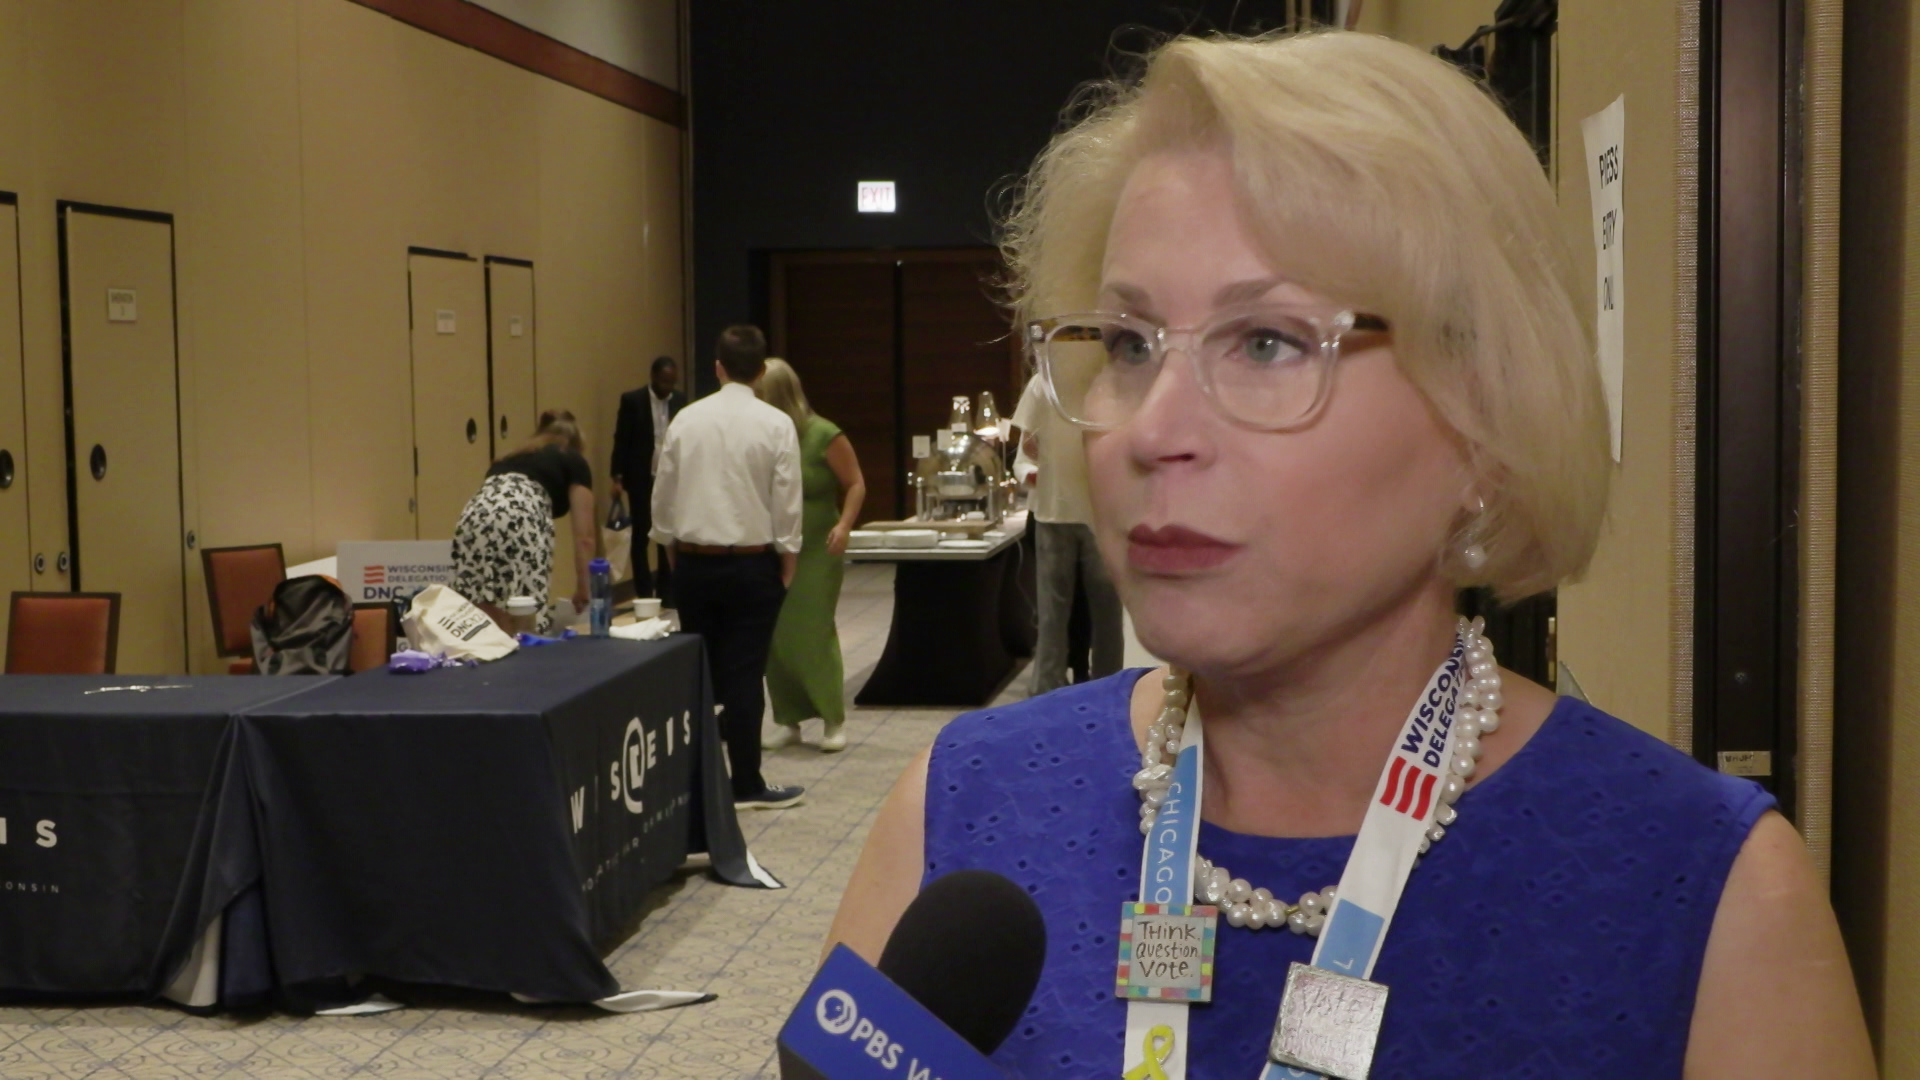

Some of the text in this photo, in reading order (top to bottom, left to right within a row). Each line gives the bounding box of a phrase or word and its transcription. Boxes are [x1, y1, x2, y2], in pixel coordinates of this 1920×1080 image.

[861, 186, 891, 207] EXIT
[1154, 782, 1182, 903] CHICAGO
[0, 881, 59, 893] ONSIN
[850, 1017, 904, 1070] PBS
